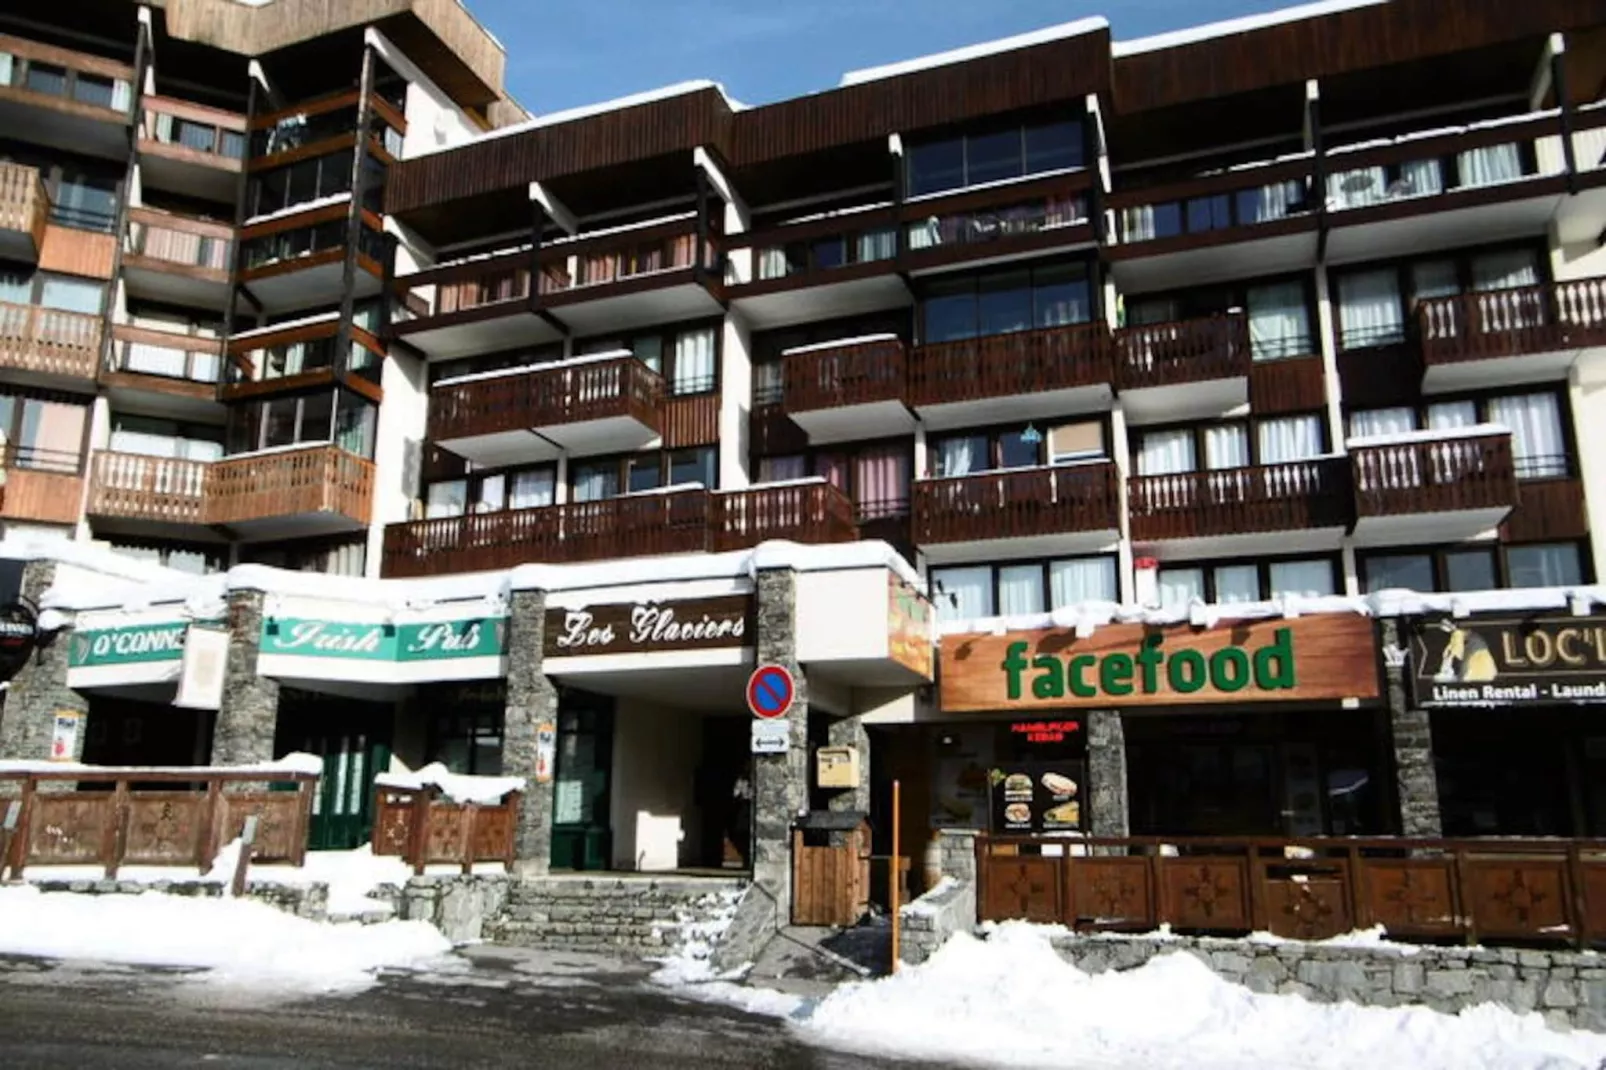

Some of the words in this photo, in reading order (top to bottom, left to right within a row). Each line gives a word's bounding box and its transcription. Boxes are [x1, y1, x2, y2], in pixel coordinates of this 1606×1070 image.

[273, 621, 383, 652] Irish
[407, 622, 481, 652] Pub
[557, 611, 615, 647] Les
[629, 603, 745, 643] Glaciers
[1001, 627, 1296, 700] facefood
[1432, 685, 1479, 701] Linen
[1482, 684, 1537, 699] Rental
[1551, 681, 1606, 698] Laund
